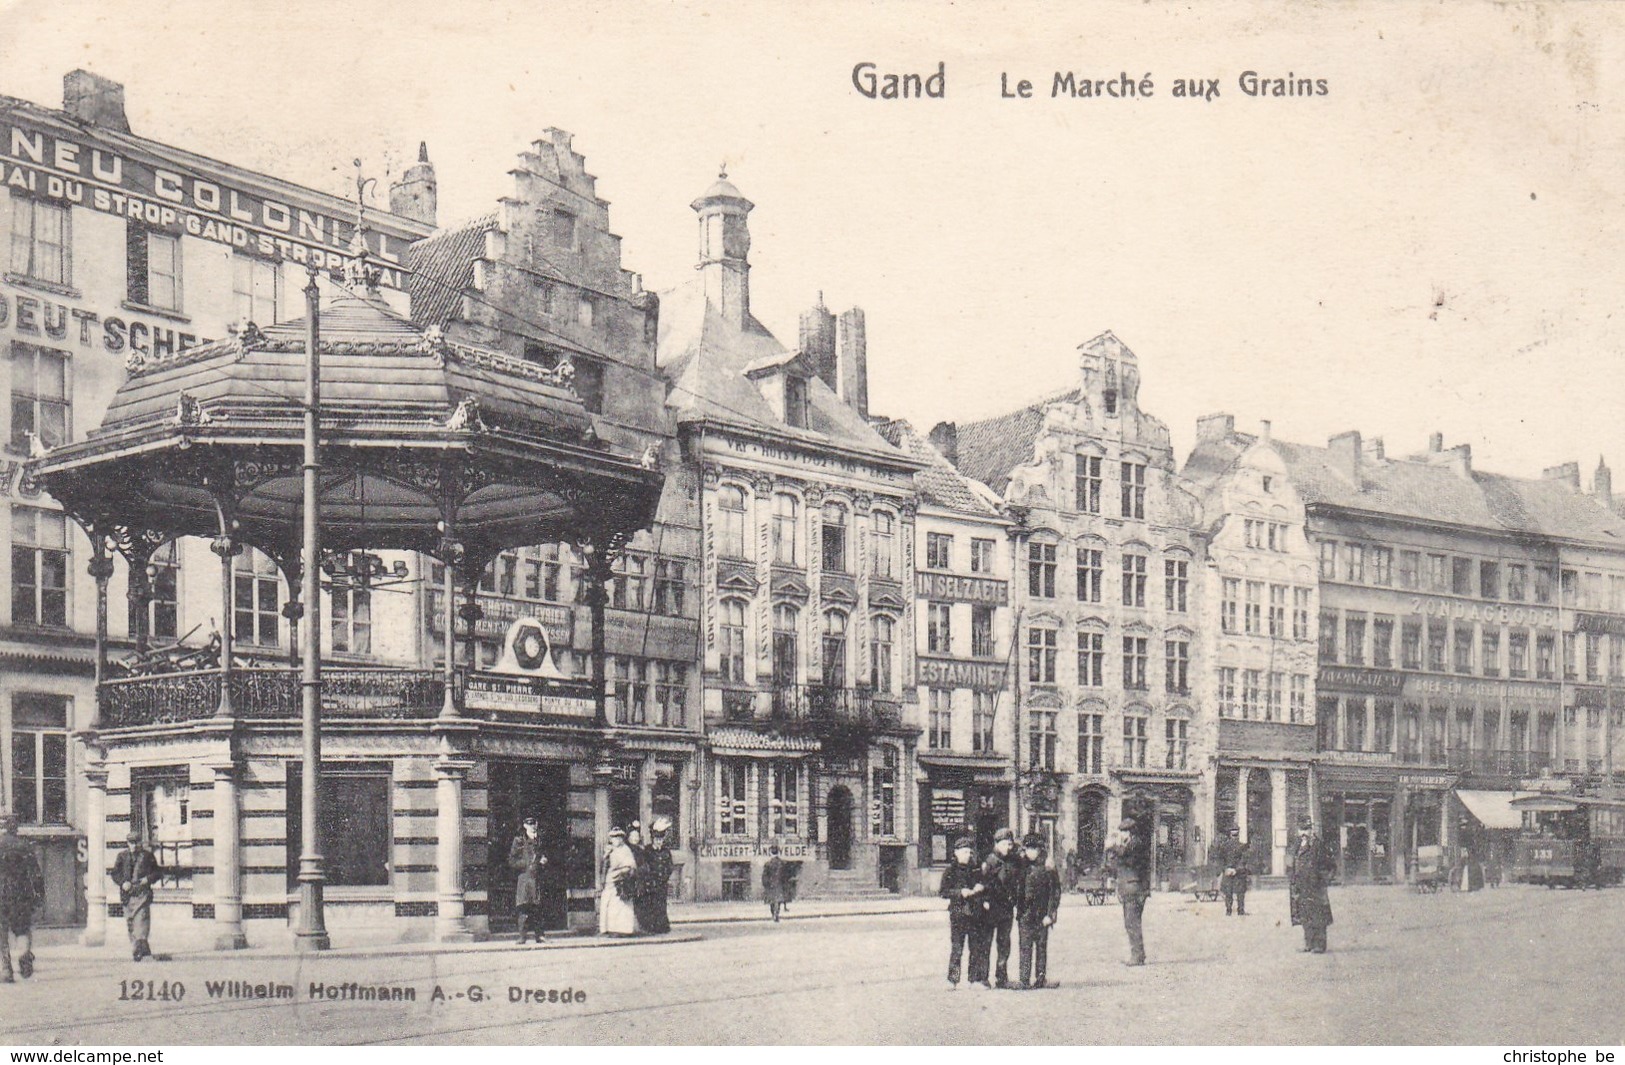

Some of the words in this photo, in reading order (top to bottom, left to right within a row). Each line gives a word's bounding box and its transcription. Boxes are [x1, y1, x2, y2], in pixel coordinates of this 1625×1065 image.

[47, 175, 83, 202] DU
[917, 573, 933, 595] IN
[919, 660, 1007, 686] ESTAMINET
